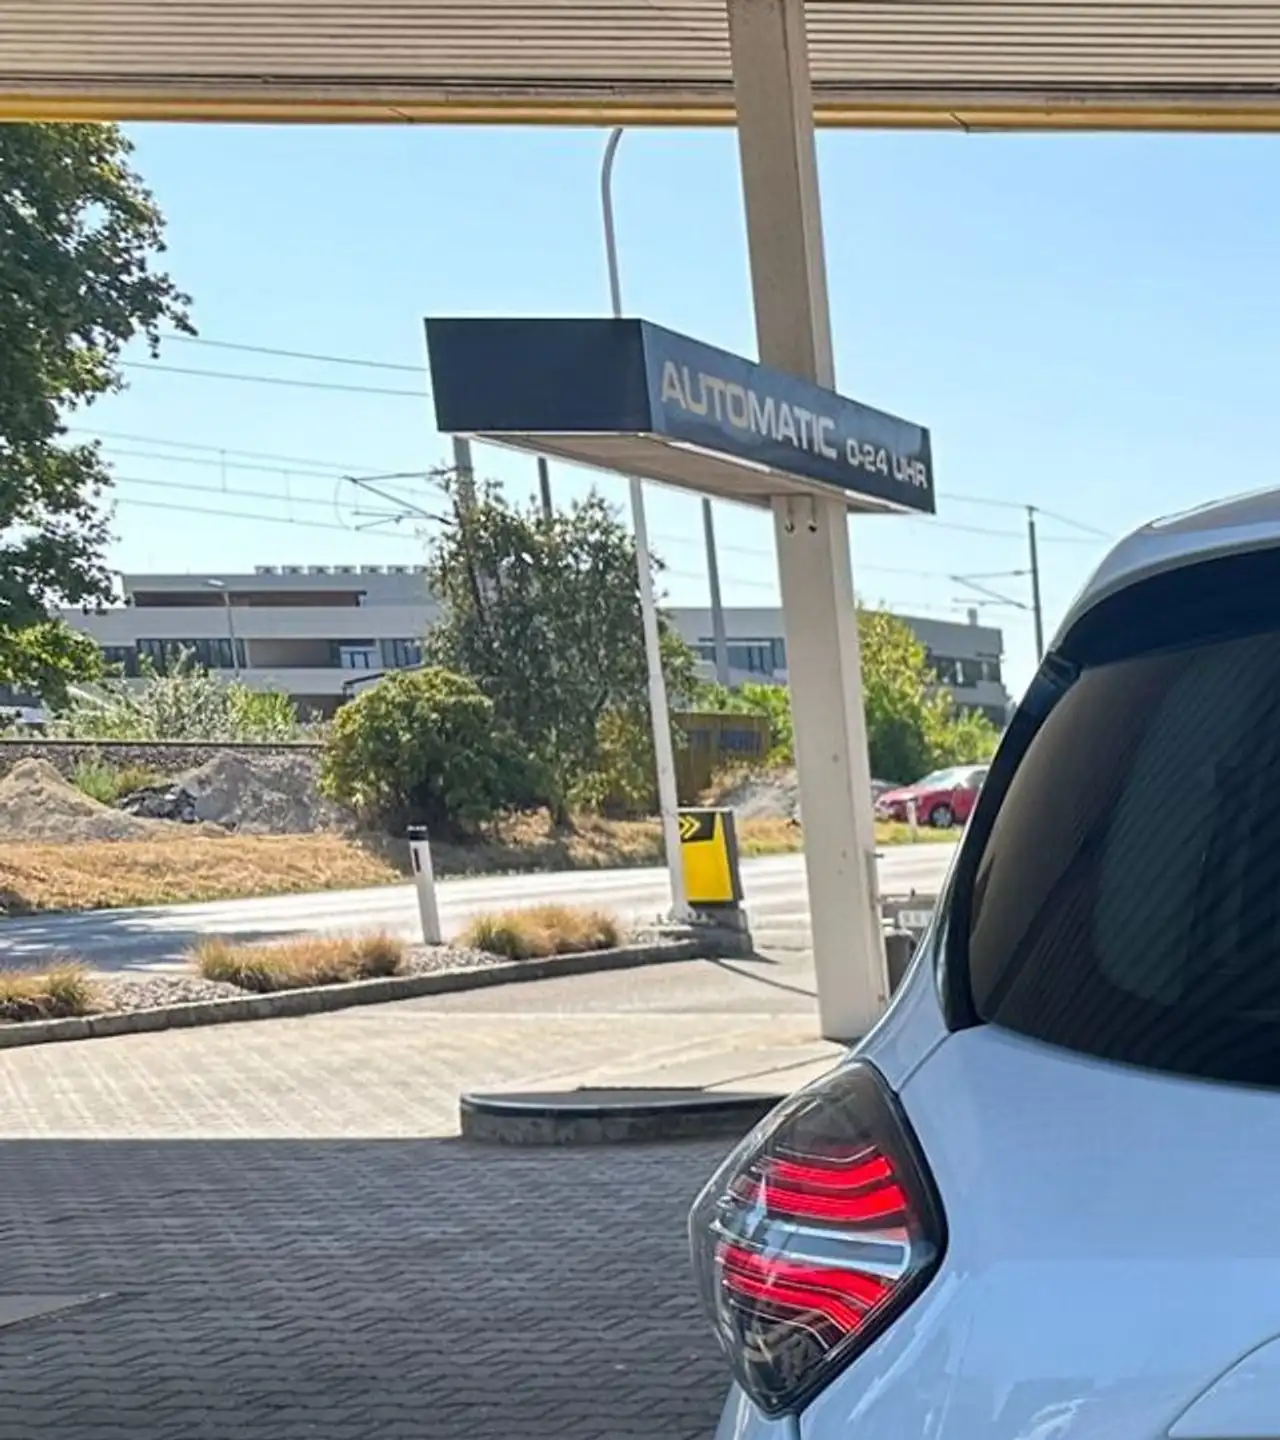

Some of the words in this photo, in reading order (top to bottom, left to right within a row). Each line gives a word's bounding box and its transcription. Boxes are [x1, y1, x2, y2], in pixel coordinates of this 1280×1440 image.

[661, 360, 837, 461] AUTOMATIC
[846, 437, 889, 477] 0-24
[891, 454, 928, 489] UHR
